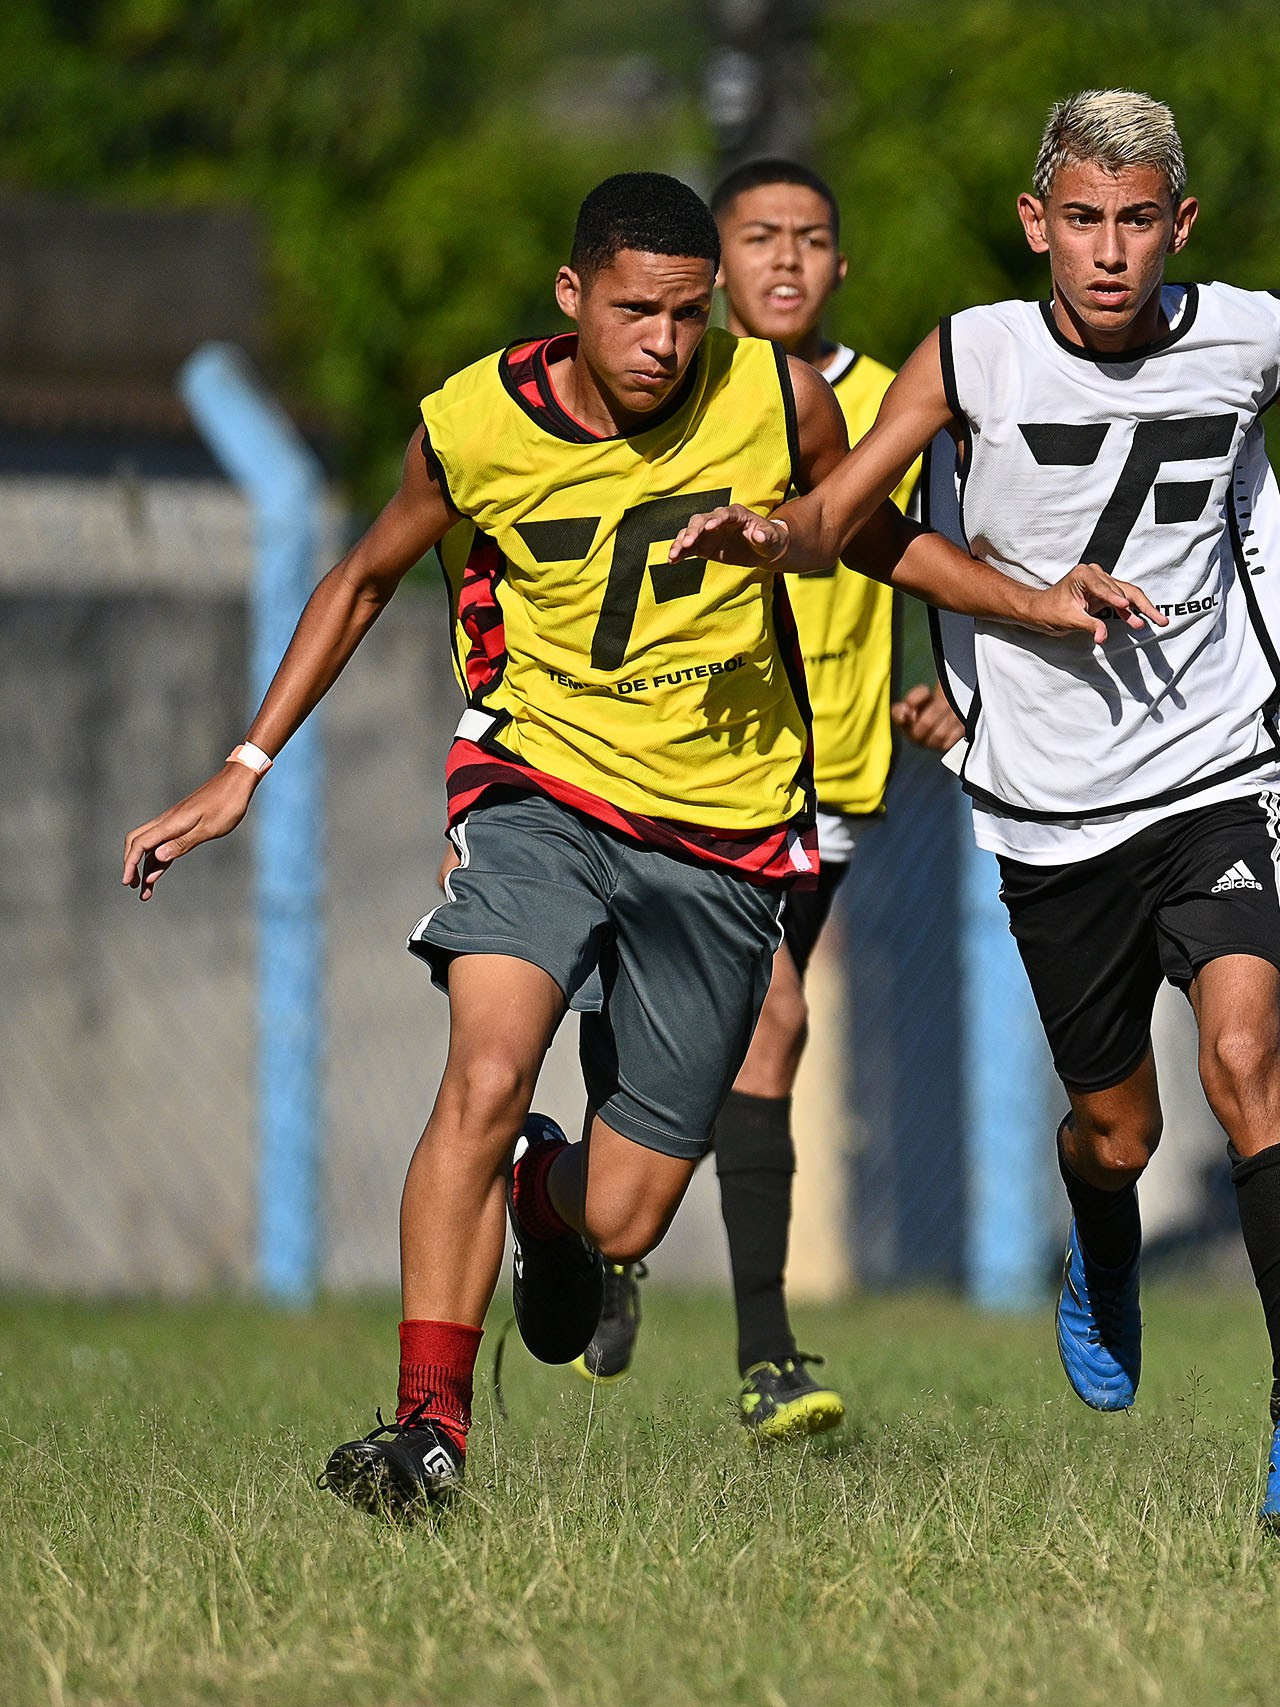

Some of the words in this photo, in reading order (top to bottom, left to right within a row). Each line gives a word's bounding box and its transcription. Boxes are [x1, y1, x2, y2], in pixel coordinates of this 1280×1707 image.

[617, 678, 648, 695] DE
[652, 656, 747, 688] FUTEBOL
[1211, 878, 1263, 893] adidas
